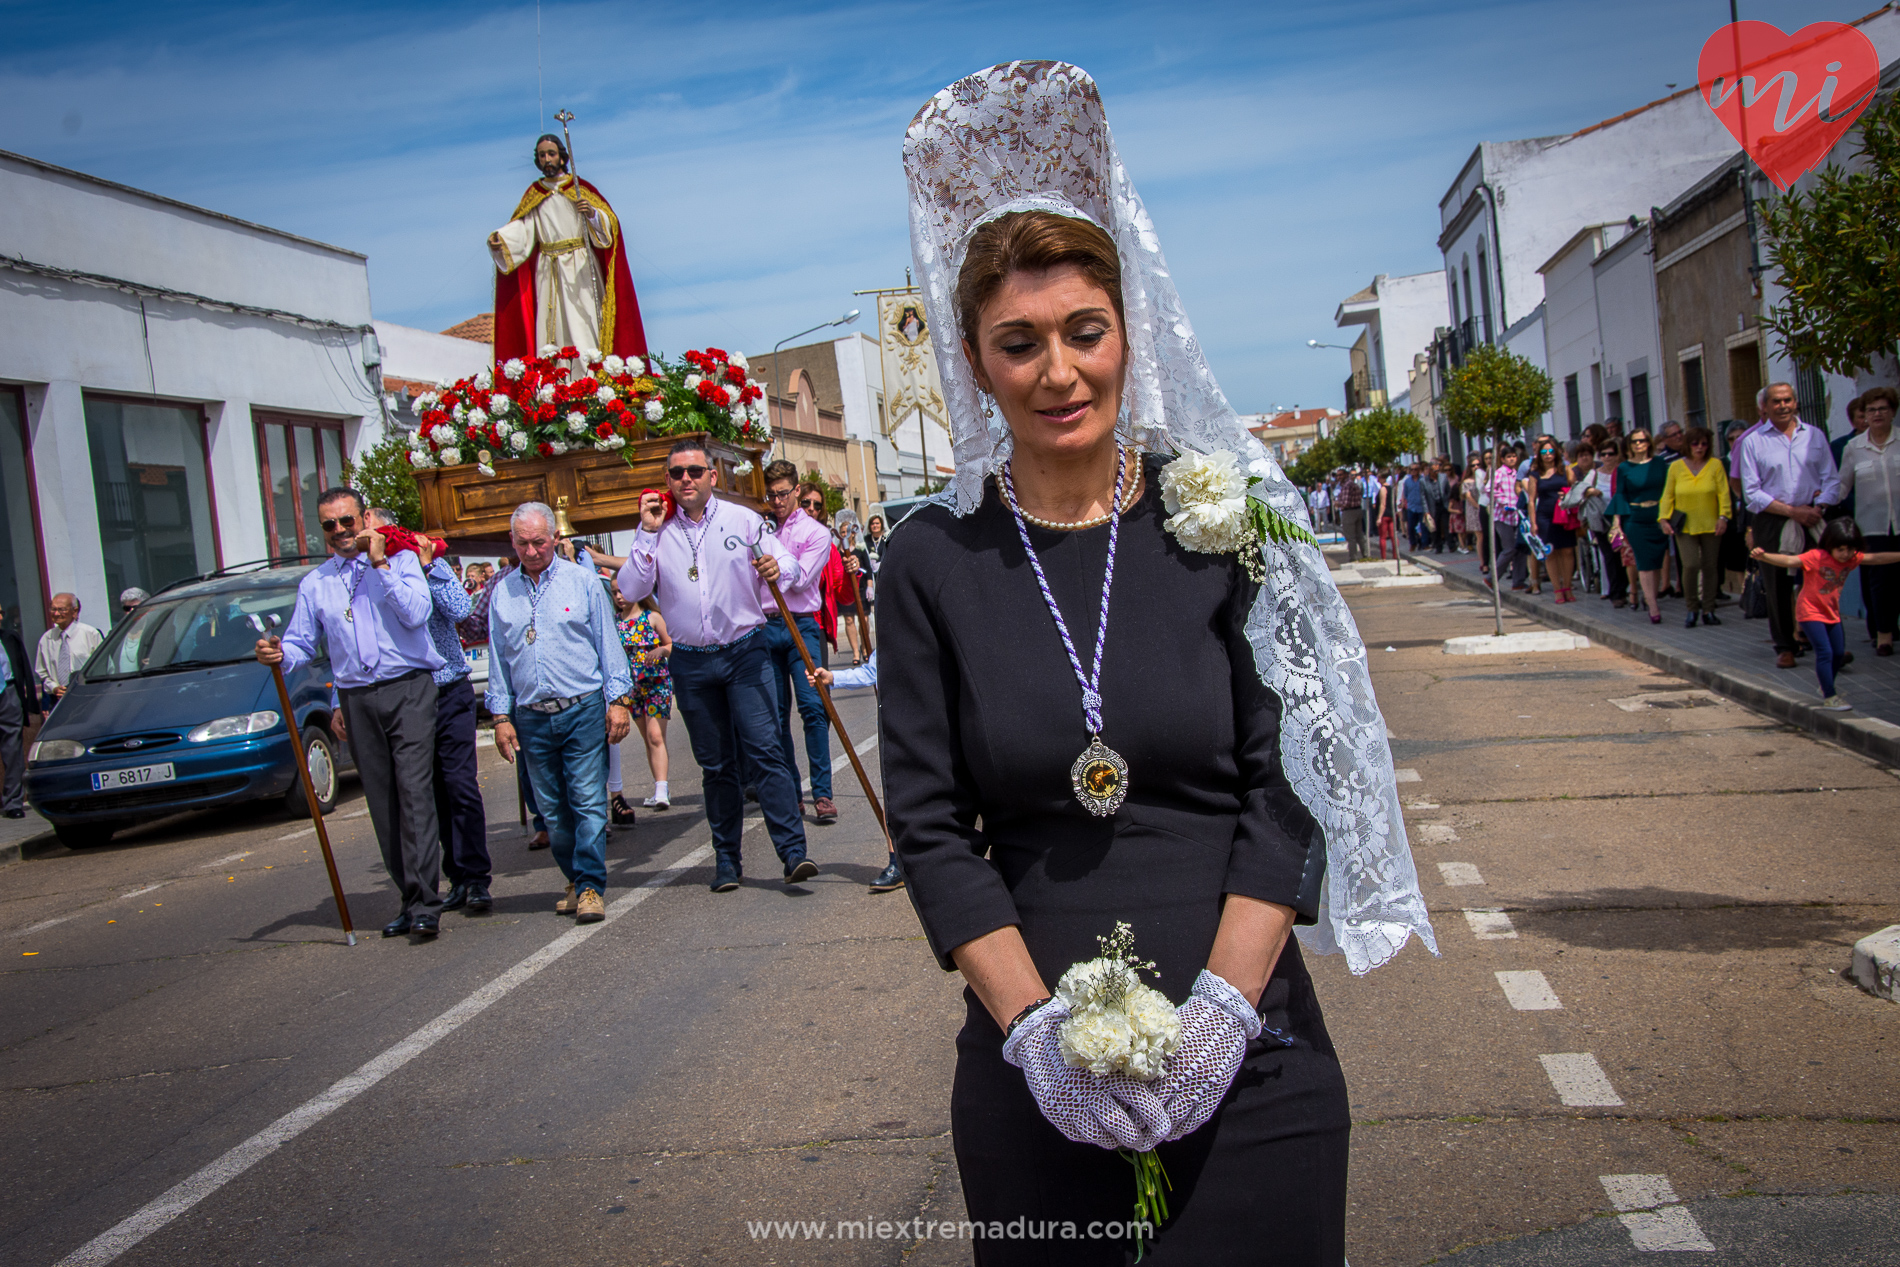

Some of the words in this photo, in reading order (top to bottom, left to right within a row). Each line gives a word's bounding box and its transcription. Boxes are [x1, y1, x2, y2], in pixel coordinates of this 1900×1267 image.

[101, 774, 109, 787] P
[119, 768, 151, 784] 6817
[164, 765, 172, 779] J
